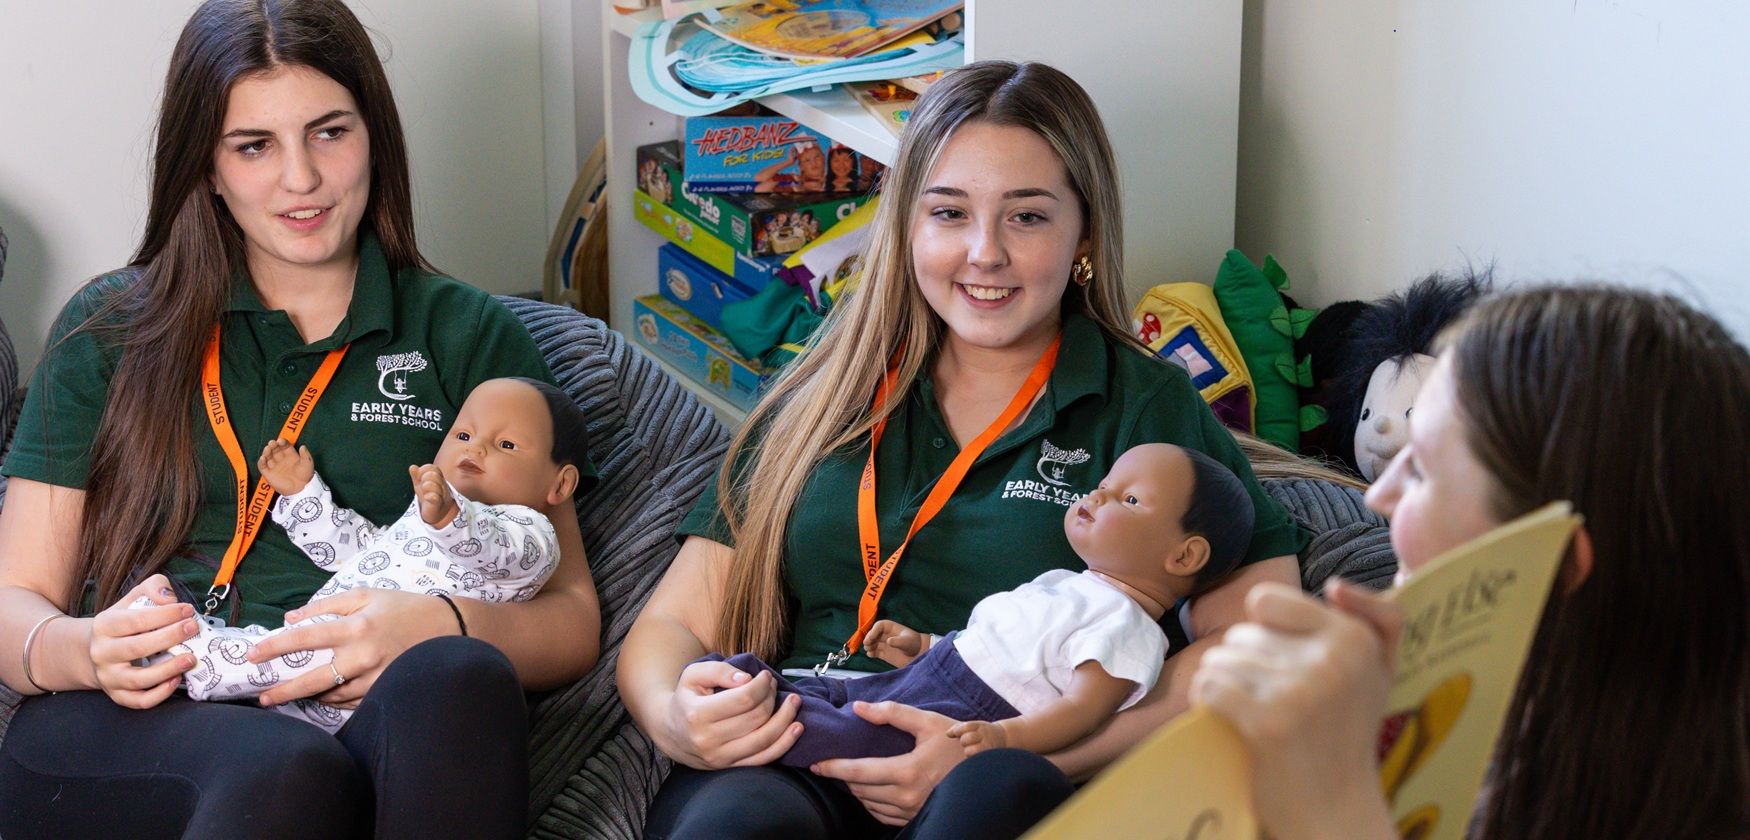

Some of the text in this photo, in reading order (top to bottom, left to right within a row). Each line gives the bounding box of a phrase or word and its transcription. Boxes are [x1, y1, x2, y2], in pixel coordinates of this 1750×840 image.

[692, 121, 817, 157] HEDBANZ
[722, 153, 749, 167] FOR
[207, 382, 225, 425] STUDENT
[287, 387, 318, 434] STUDENT
[351, 402, 443, 422] EARLY YEARS
[350, 413, 443, 431] & FOREST SCHOOL
[1001, 490, 1054, 502] & FOREST
[1004, 479, 1050, 494] EARLY
[244, 481, 271, 537] STUDENT
[868, 548, 902, 601] STUDENT
